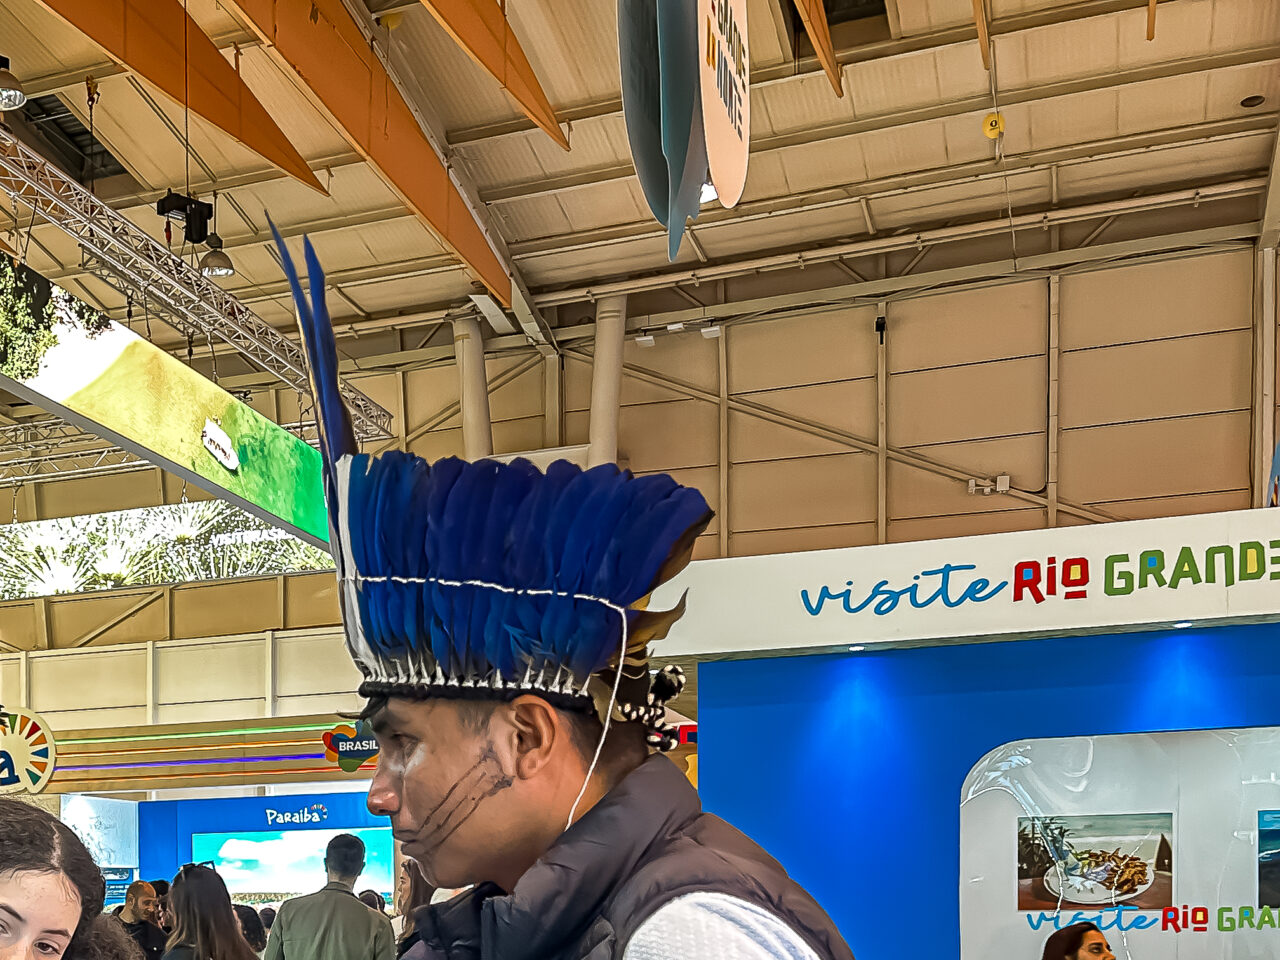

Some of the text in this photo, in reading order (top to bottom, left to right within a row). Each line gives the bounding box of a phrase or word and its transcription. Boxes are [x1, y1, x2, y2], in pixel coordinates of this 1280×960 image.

[800, 563, 1009, 616] visite
[338, 740, 379, 751] BRASIL
[1217, 904, 1280, 932] GRA
